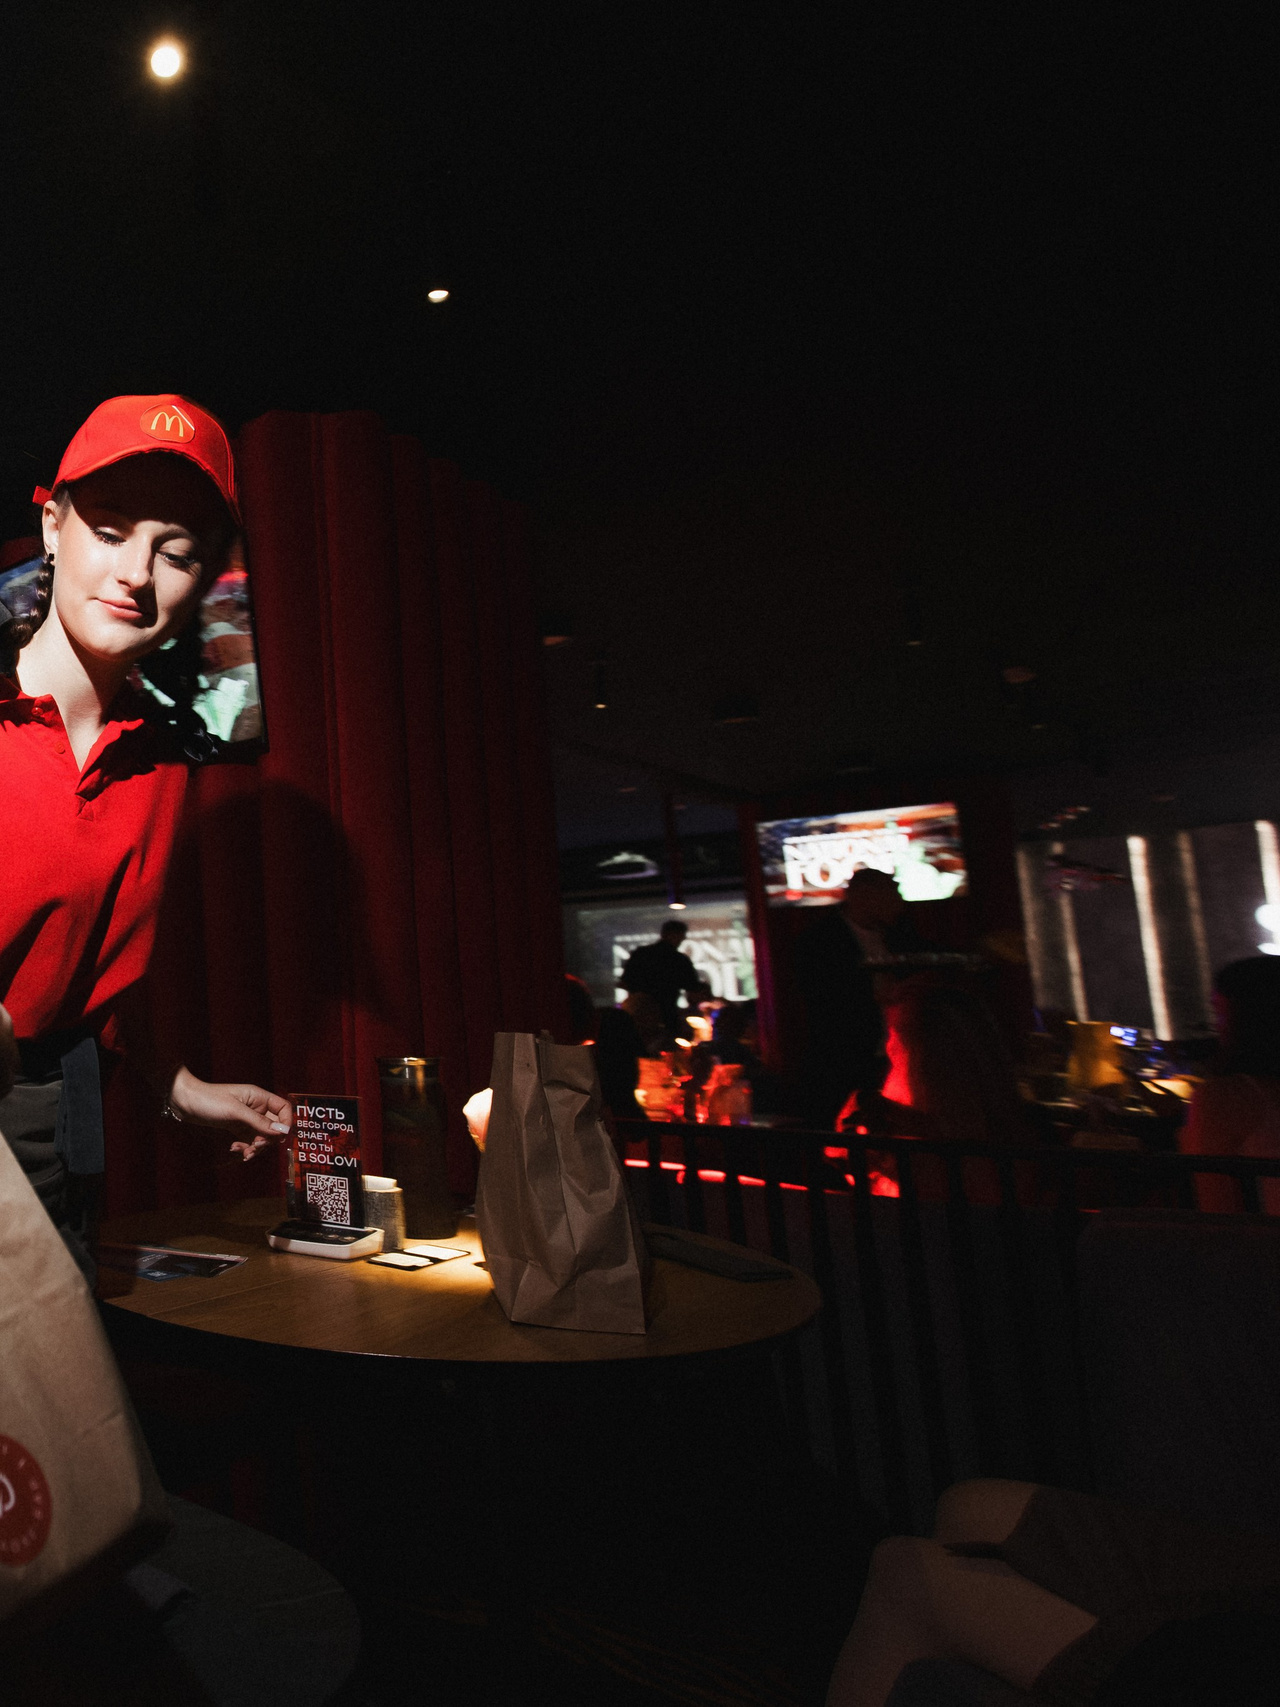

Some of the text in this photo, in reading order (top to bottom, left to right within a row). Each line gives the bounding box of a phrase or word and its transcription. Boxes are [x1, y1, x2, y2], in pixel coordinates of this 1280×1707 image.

[296, 1105, 345, 1120] ПУСТЬ
[297, 1120, 354, 1133] ВЕСЬ ГОРОД
[297, 1131, 331, 1142] ЗНАЕТ,
[298, 1142, 333, 1152] ЧТО ТЫ
[298, 1152, 358, 1168] В SOLOVI
